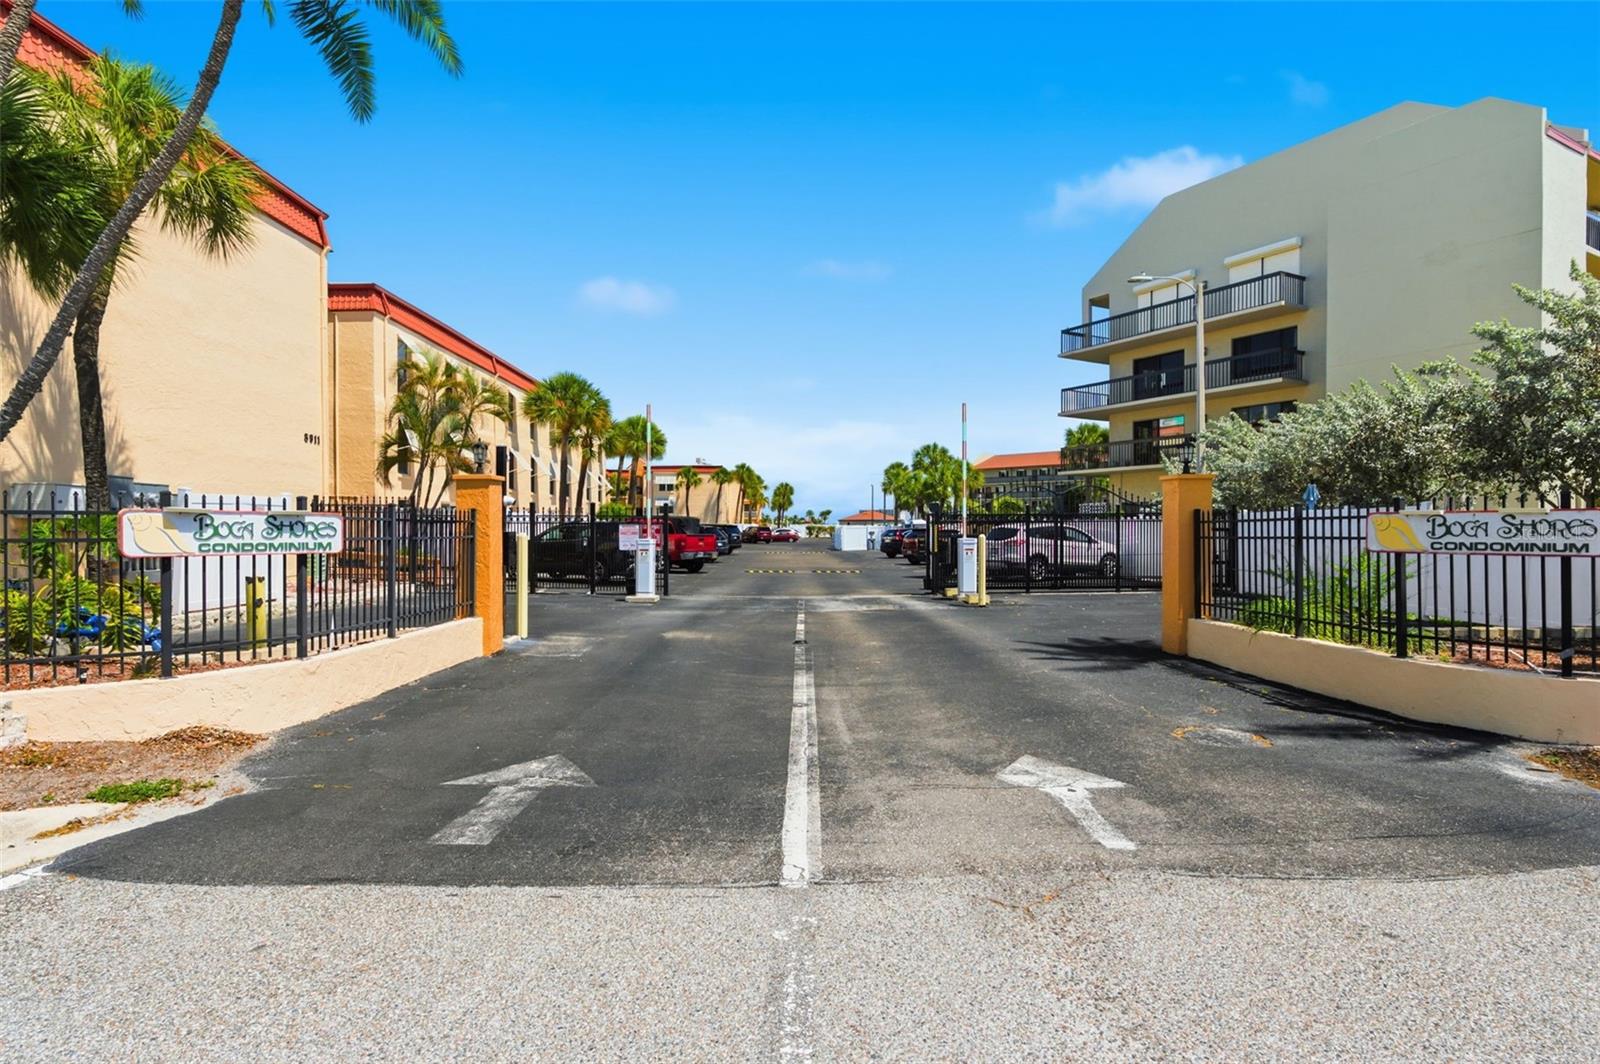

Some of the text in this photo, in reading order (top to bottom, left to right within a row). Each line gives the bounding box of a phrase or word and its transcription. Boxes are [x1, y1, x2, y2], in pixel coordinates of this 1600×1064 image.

[304, 432, 320, 446] 8911
[198, 542, 332, 553] CONDOMINIUM
[1430, 541, 1590, 553] CONDOMINIUM
